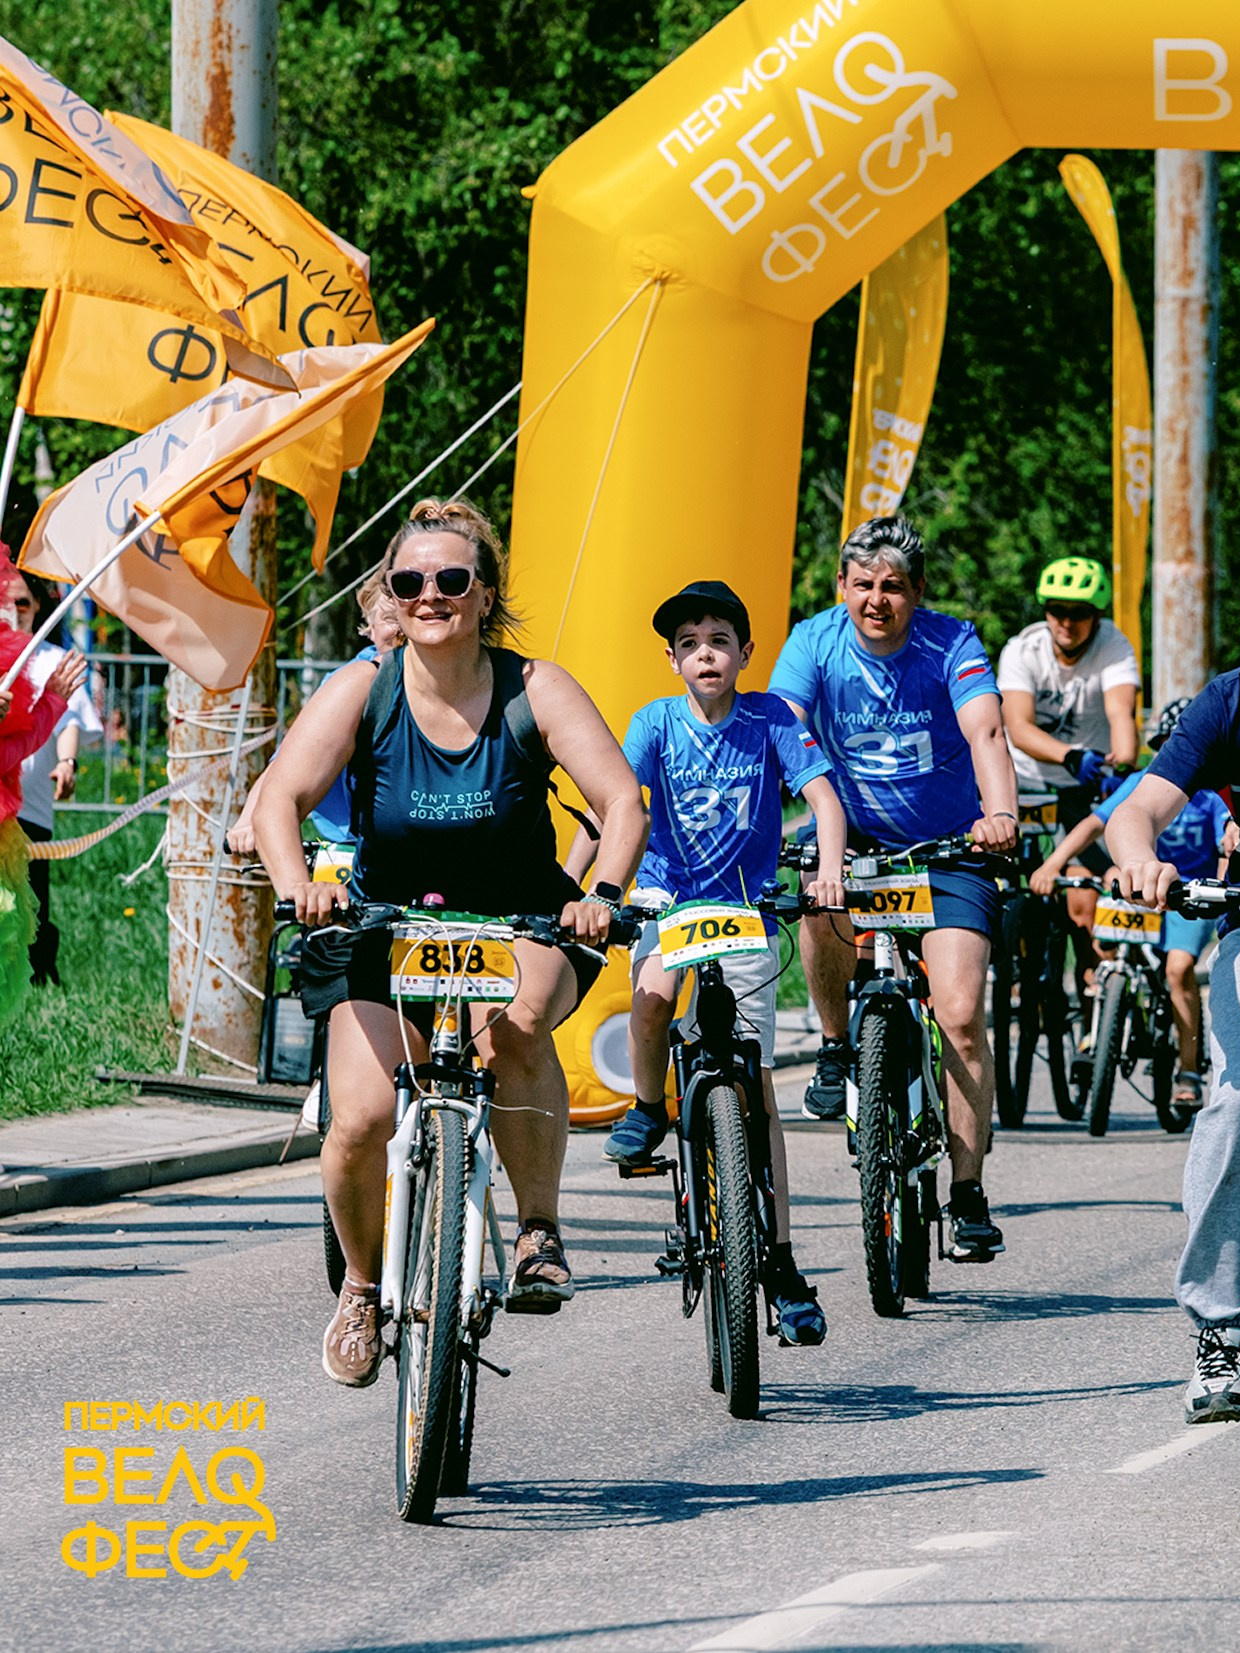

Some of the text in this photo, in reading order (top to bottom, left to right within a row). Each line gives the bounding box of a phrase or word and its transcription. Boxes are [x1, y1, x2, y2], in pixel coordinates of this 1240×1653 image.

[1154, 38, 1232, 121] В
[844, 731, 933, 775] 31
[410, 790, 491, 806] CAN'T STOP
[678, 786, 750, 831] 31
[680, 918, 741, 945] 706
